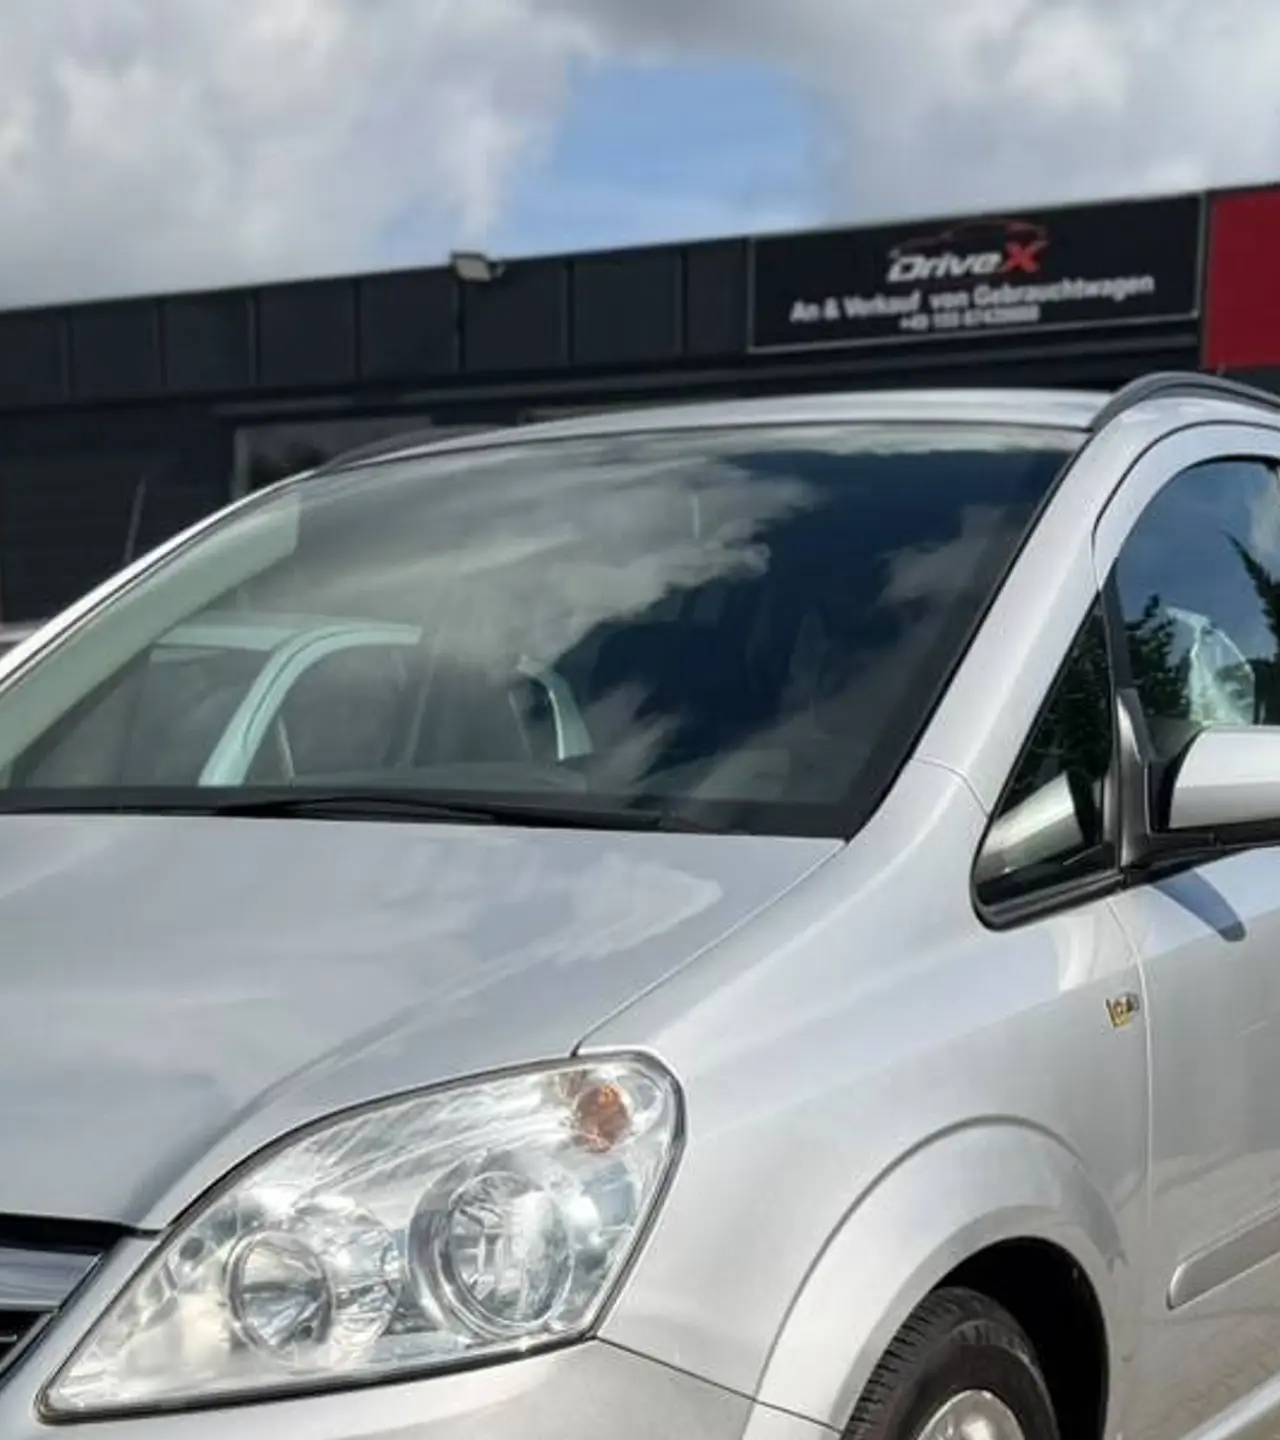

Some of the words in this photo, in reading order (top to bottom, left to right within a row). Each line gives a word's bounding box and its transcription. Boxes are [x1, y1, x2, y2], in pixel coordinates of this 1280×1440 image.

[885, 239, 1049, 283] DriveX
[788, 299, 819, 325] An
[842, 289, 921, 319] Verkauf
[927, 291, 968, 311] von
[973, 274, 1155, 307] Gebrauchtwagen
